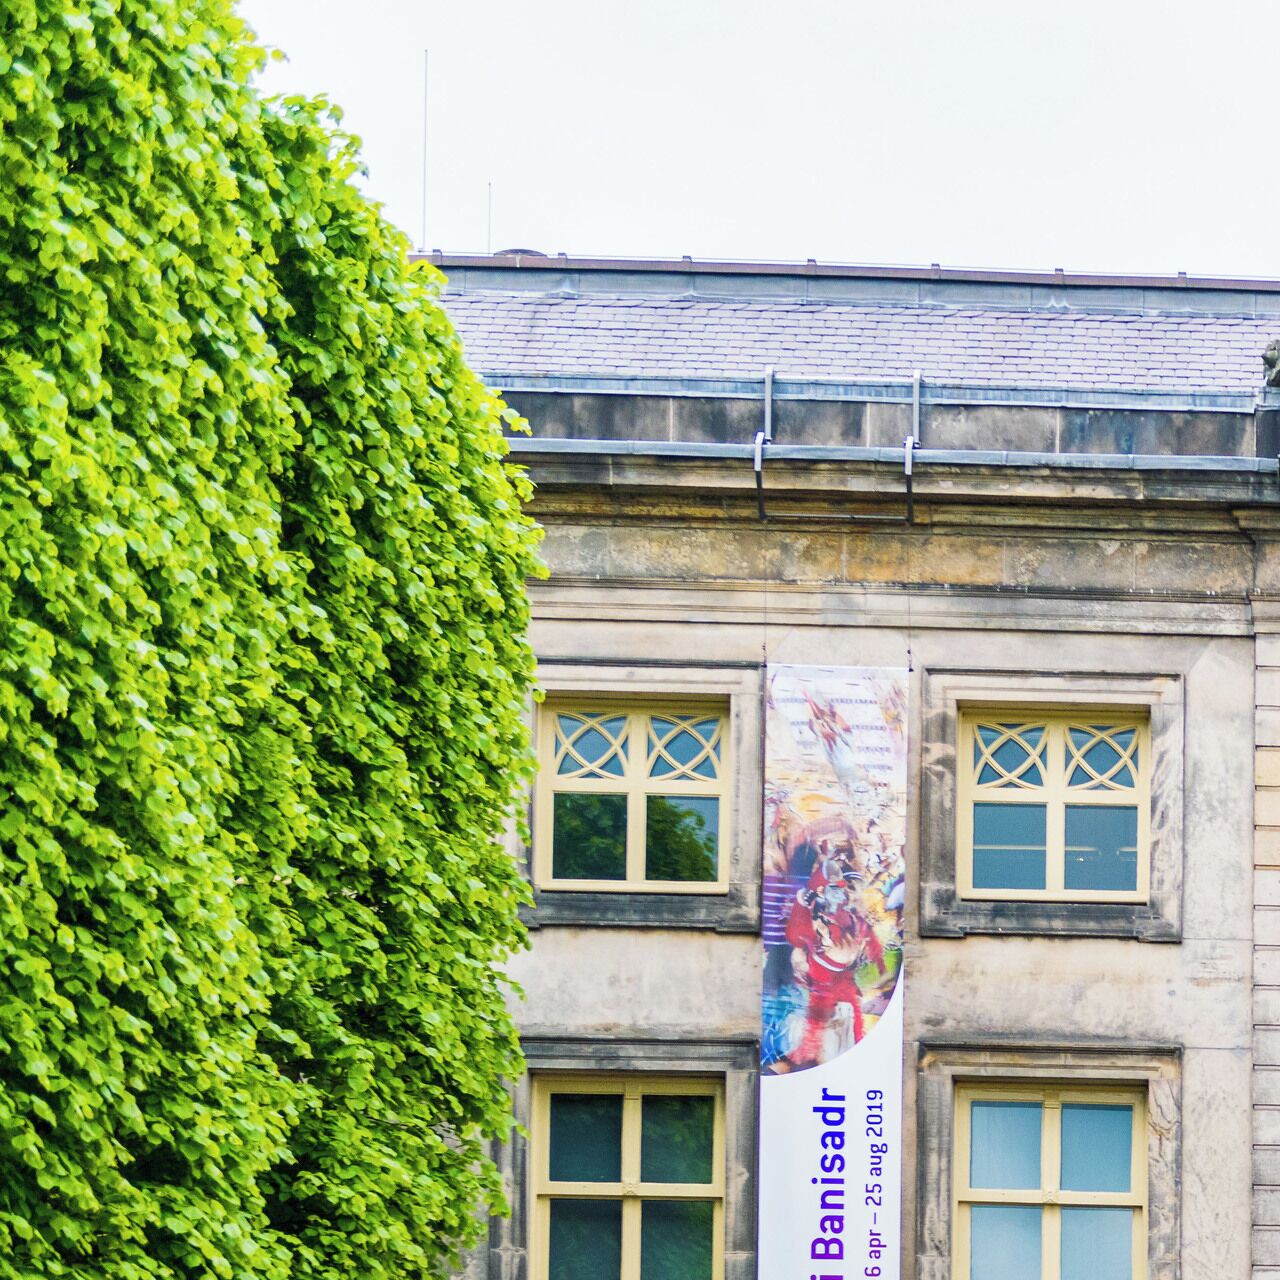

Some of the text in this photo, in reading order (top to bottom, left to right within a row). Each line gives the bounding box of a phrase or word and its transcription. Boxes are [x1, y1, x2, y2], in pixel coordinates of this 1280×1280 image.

[866, 1089, 884, 1138] 2019
[810, 1087, 846, 1260] Banisadr
[870, 1142, 889, 1177] aug
[865, 1183, 883, 1207] 25
[868, 1229, 888, 1260] apr
[864, 1266, 882, 1278] 6
